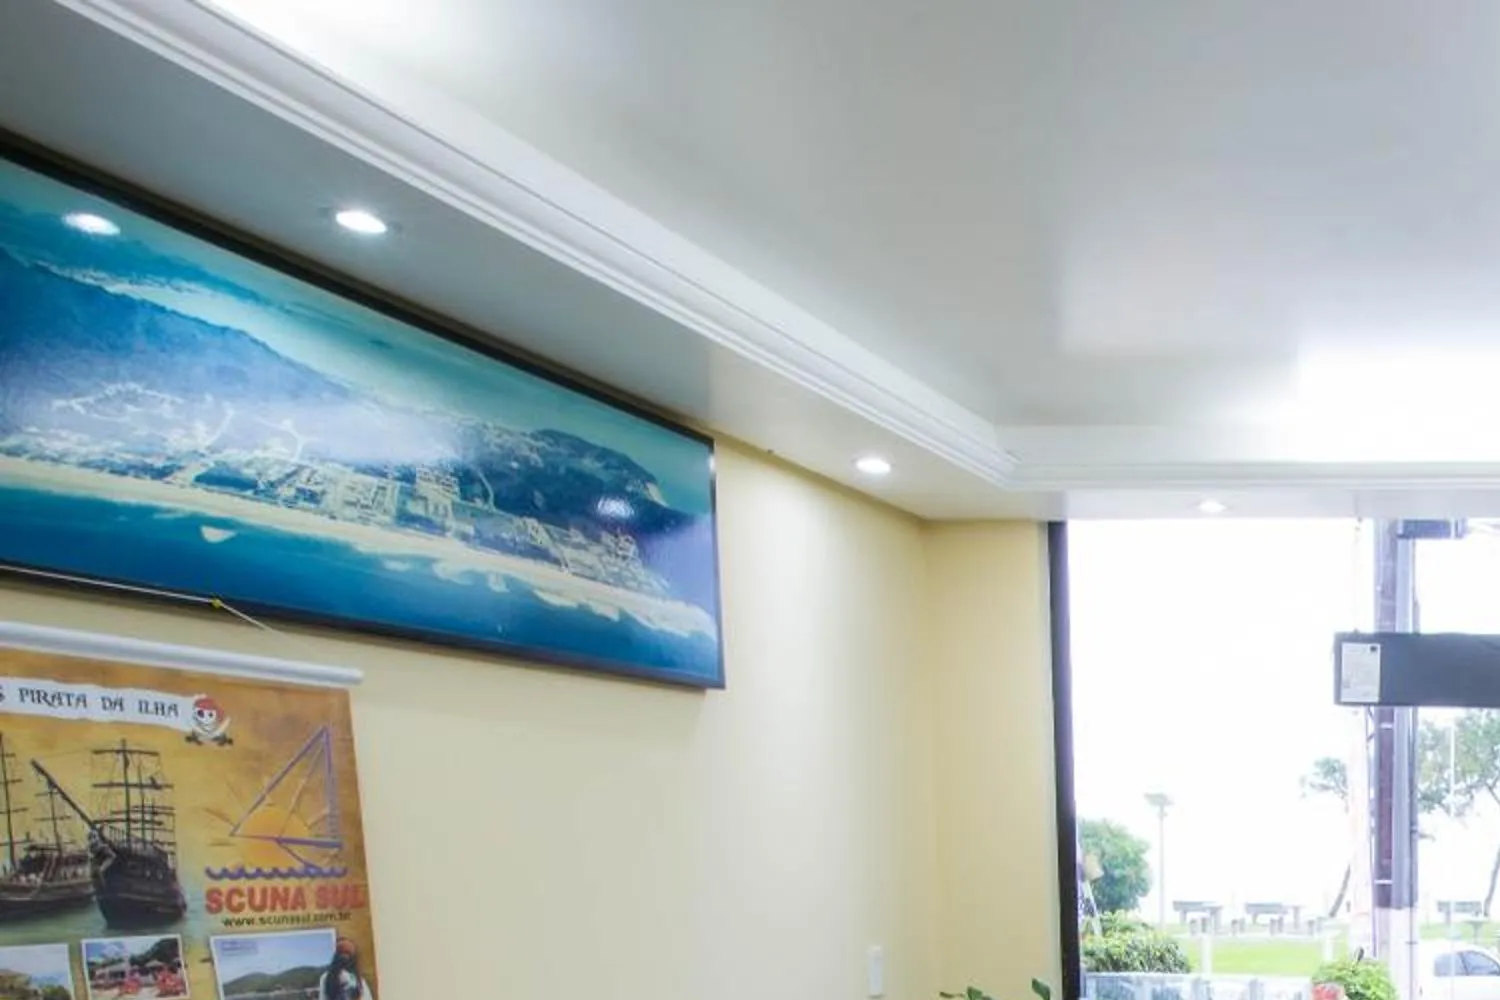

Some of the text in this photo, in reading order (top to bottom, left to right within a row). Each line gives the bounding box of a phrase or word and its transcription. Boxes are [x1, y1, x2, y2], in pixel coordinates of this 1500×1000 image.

[18, 687, 88, 710] PIRATA
[101, 696, 125, 713] DA
[138, 700, 179, 717] ILHA
[205, 883, 365, 915] SCUNA SUL
